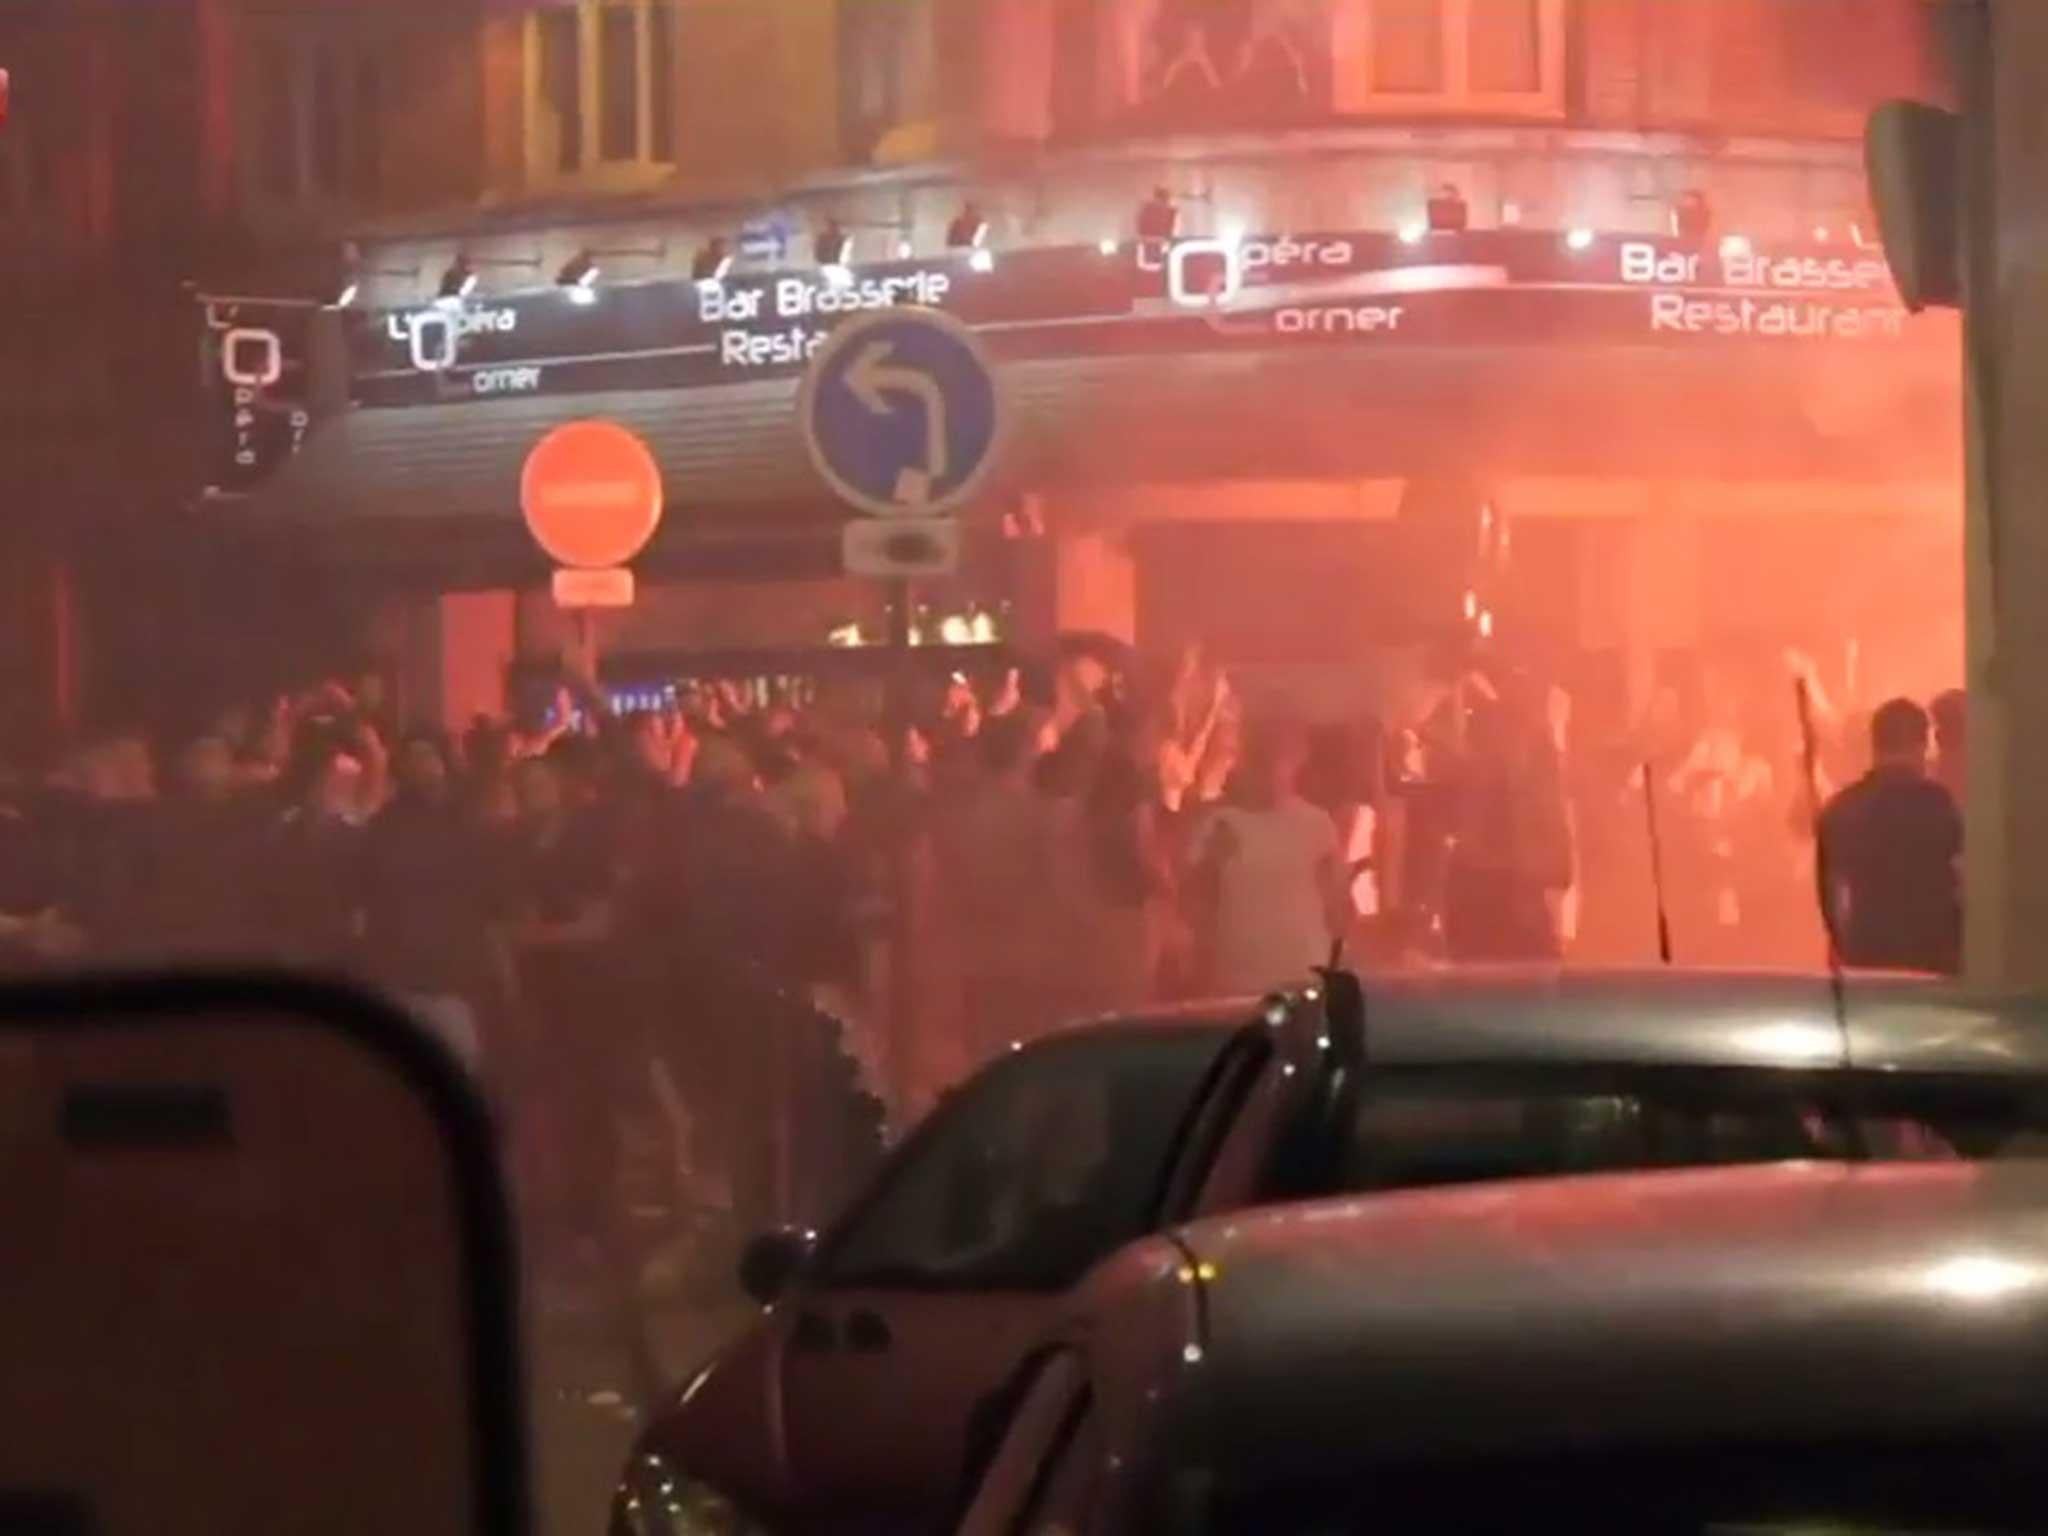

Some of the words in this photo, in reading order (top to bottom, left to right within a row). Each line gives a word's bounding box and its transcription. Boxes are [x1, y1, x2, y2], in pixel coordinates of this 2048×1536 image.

[1619, 243, 1700, 284] Bar
[1719, 248, 1885, 289] Brasse
[698, 278, 764, 322] Bar
